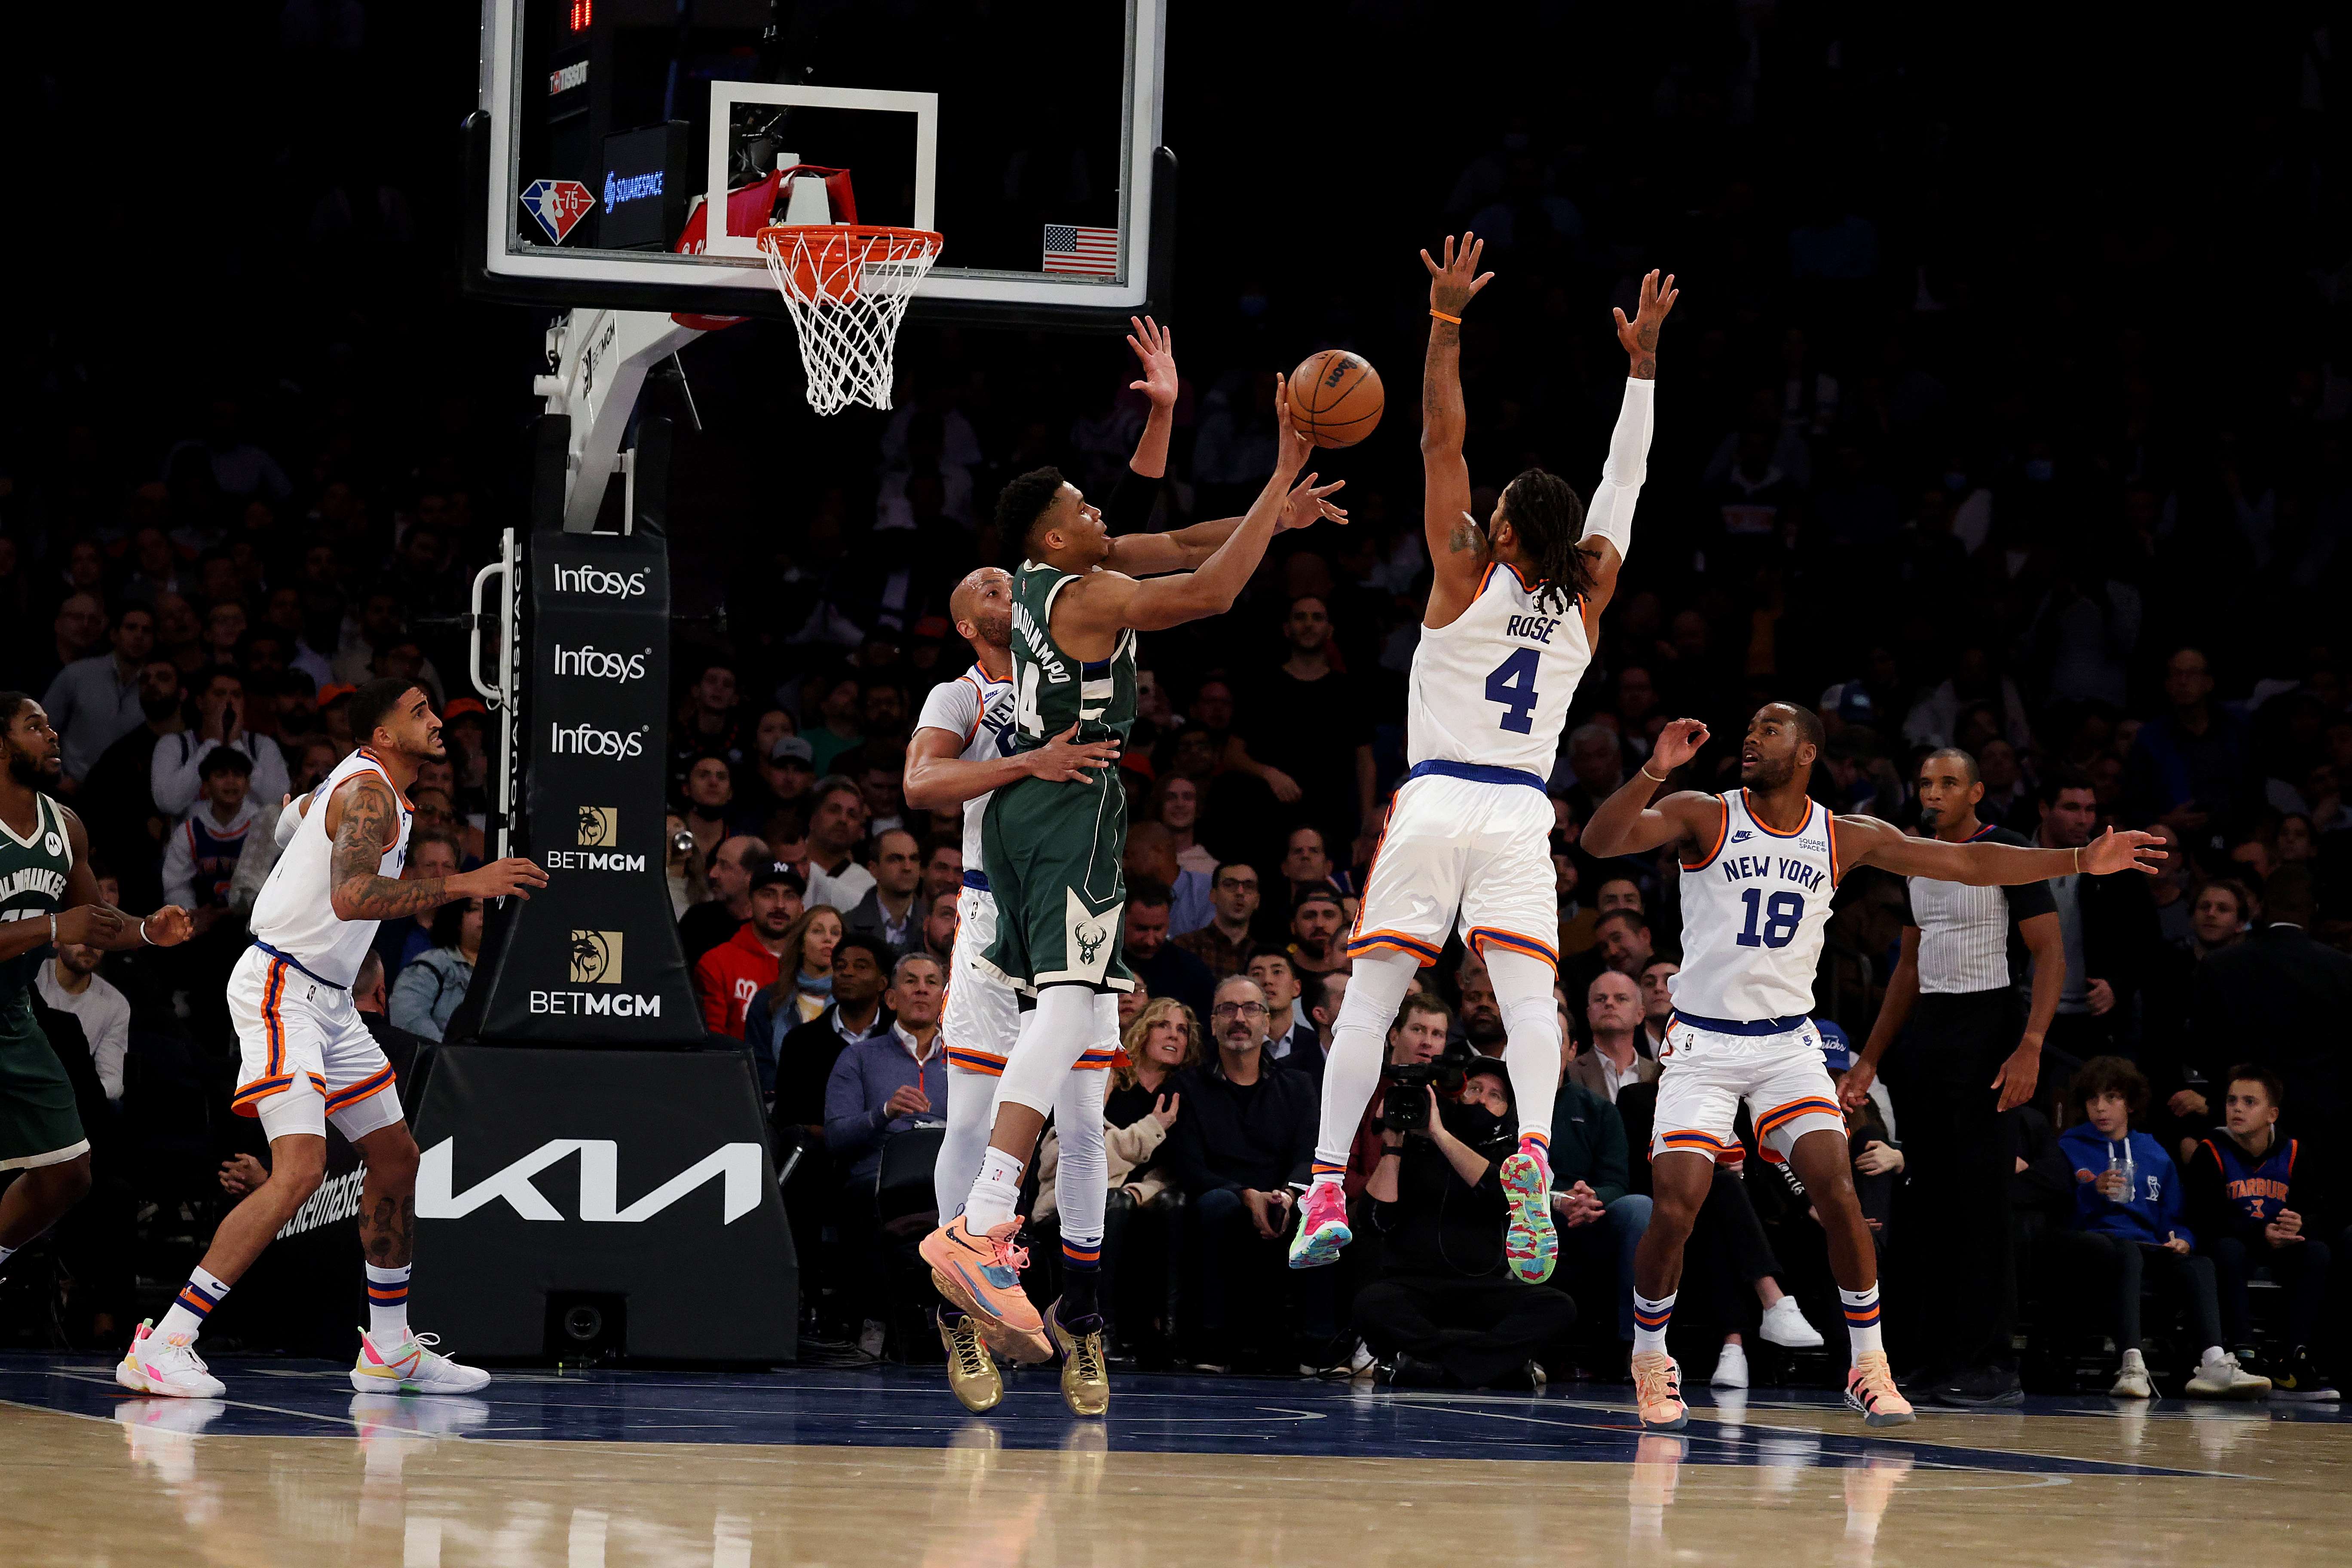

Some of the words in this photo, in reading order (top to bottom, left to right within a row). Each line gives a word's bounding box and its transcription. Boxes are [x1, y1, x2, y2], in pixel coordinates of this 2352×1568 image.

[564, 190, 578, 210] 75
[616, 171, 664, 202] SQUARESPACE
[592, 319, 615, 371] BETMGM
[555, 564, 645, 599] Infosys
[1012, 601, 1071, 683] OKOUNMPO
[1507, 615, 1561, 645] ROSE
[555, 644, 645, 683] Infosys
[510, 542, 521, 831] SQUARESPACE
[985, 689, 999, 699] NIKE
[1011, 651, 1045, 738] 4
[1485, 647, 1541, 735] 4
[552, 722, 643, 761] Infosys
[1735, 830, 1752, 838] NIKE
[1799, 838, 1825, 847] SQUARE
[1799, 843, 1820, 852] SPACE
[547, 851, 645, 872] BETMGM
[1723, 856, 1770, 882] NEW
[1779, 858, 1825, 893] YORK
[0, 867, 67, 902] ILWAUKEE
[1736, 888, 1805, 949] 18
[530, 991, 660, 1017] BETMGM
[415, 1136, 762, 1225] KIA
[2249, 1198, 2265, 1218] 3
